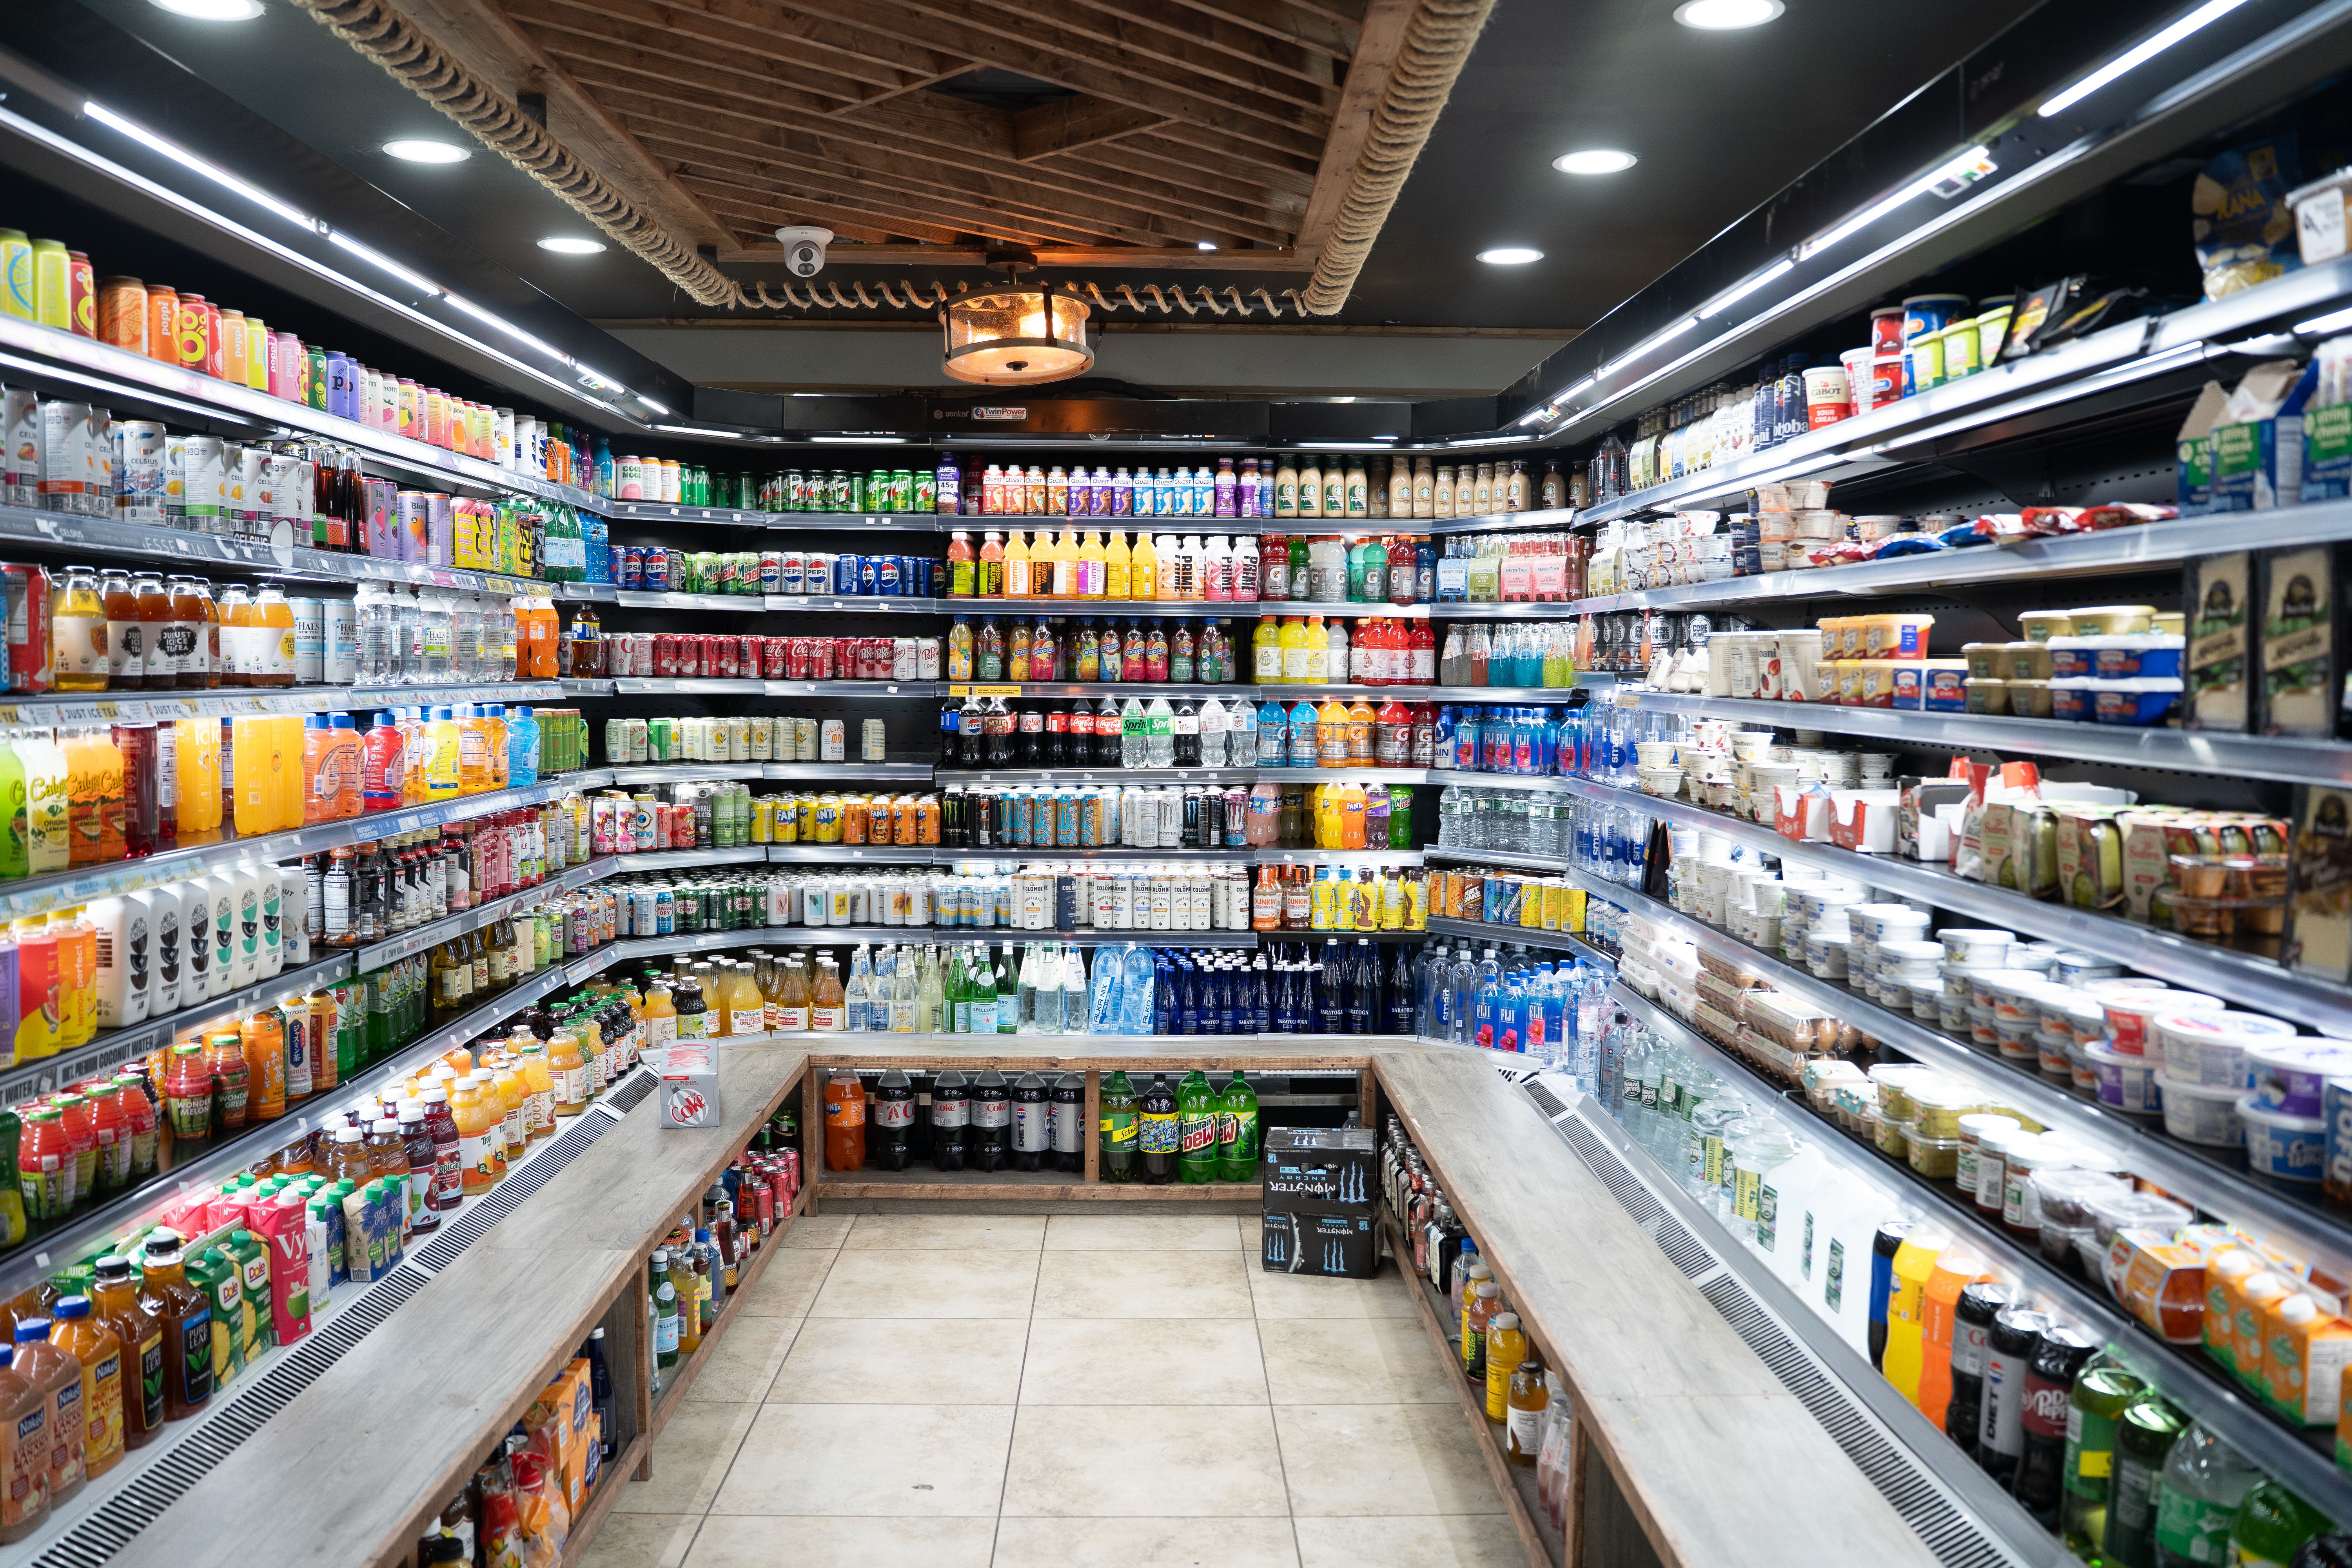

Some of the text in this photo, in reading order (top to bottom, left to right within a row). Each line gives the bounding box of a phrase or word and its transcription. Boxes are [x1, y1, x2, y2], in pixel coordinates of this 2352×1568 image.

[158, 301, 171, 336] poppi
[299, 622, 319, 630] HAL'S
[1033, 647, 1054, 656] snapple
[1100, 642, 1120, 651] snapple
[1125, 647, 1144, 656] snapple
[921, 650, 940, 661] Pepper
[1123, 720, 1146, 730] Sprite
[1459, 733, 1474, 743] FIJI
[1496, 733, 1510, 744] FIJI
[1347, 802, 1363, 810] FANTA
[358, 831, 378, 839] HYDRATION
[1503, 886, 1523, 919] Nutrament
[1094, 998, 1106, 1023] ALKA
[1100, 983, 1108, 998] NIX
[1143, 1000, 1151, 1024] ALKA
[293, 1025, 301, 1062] ジャスミン茶
[99, 1034, 154, 1069] COCONUT WATER
[177, 1098, 211, 1109] WONDER
[219, 1093, 249, 1103] WONDER
[224, 1098, 247, 1108] GREEN
[180, 1105, 210, 1116] MELON
[532, 1093, 542, 1125] 100%
[672, 1094, 706, 1122] Coke
[437, 1161, 461, 1174] ropicana
[248, 1261, 267, 1282] Dole
[222, 1280, 238, 1301] Dole
[188, 1321, 208, 1338] PURE
[189, 1333, 208, 1347] LEAF
[95, 1354, 119, 1383] Naked
[58, 1380, 80, 1410] Naked
[1986, 1386, 1996, 1439] DIET
